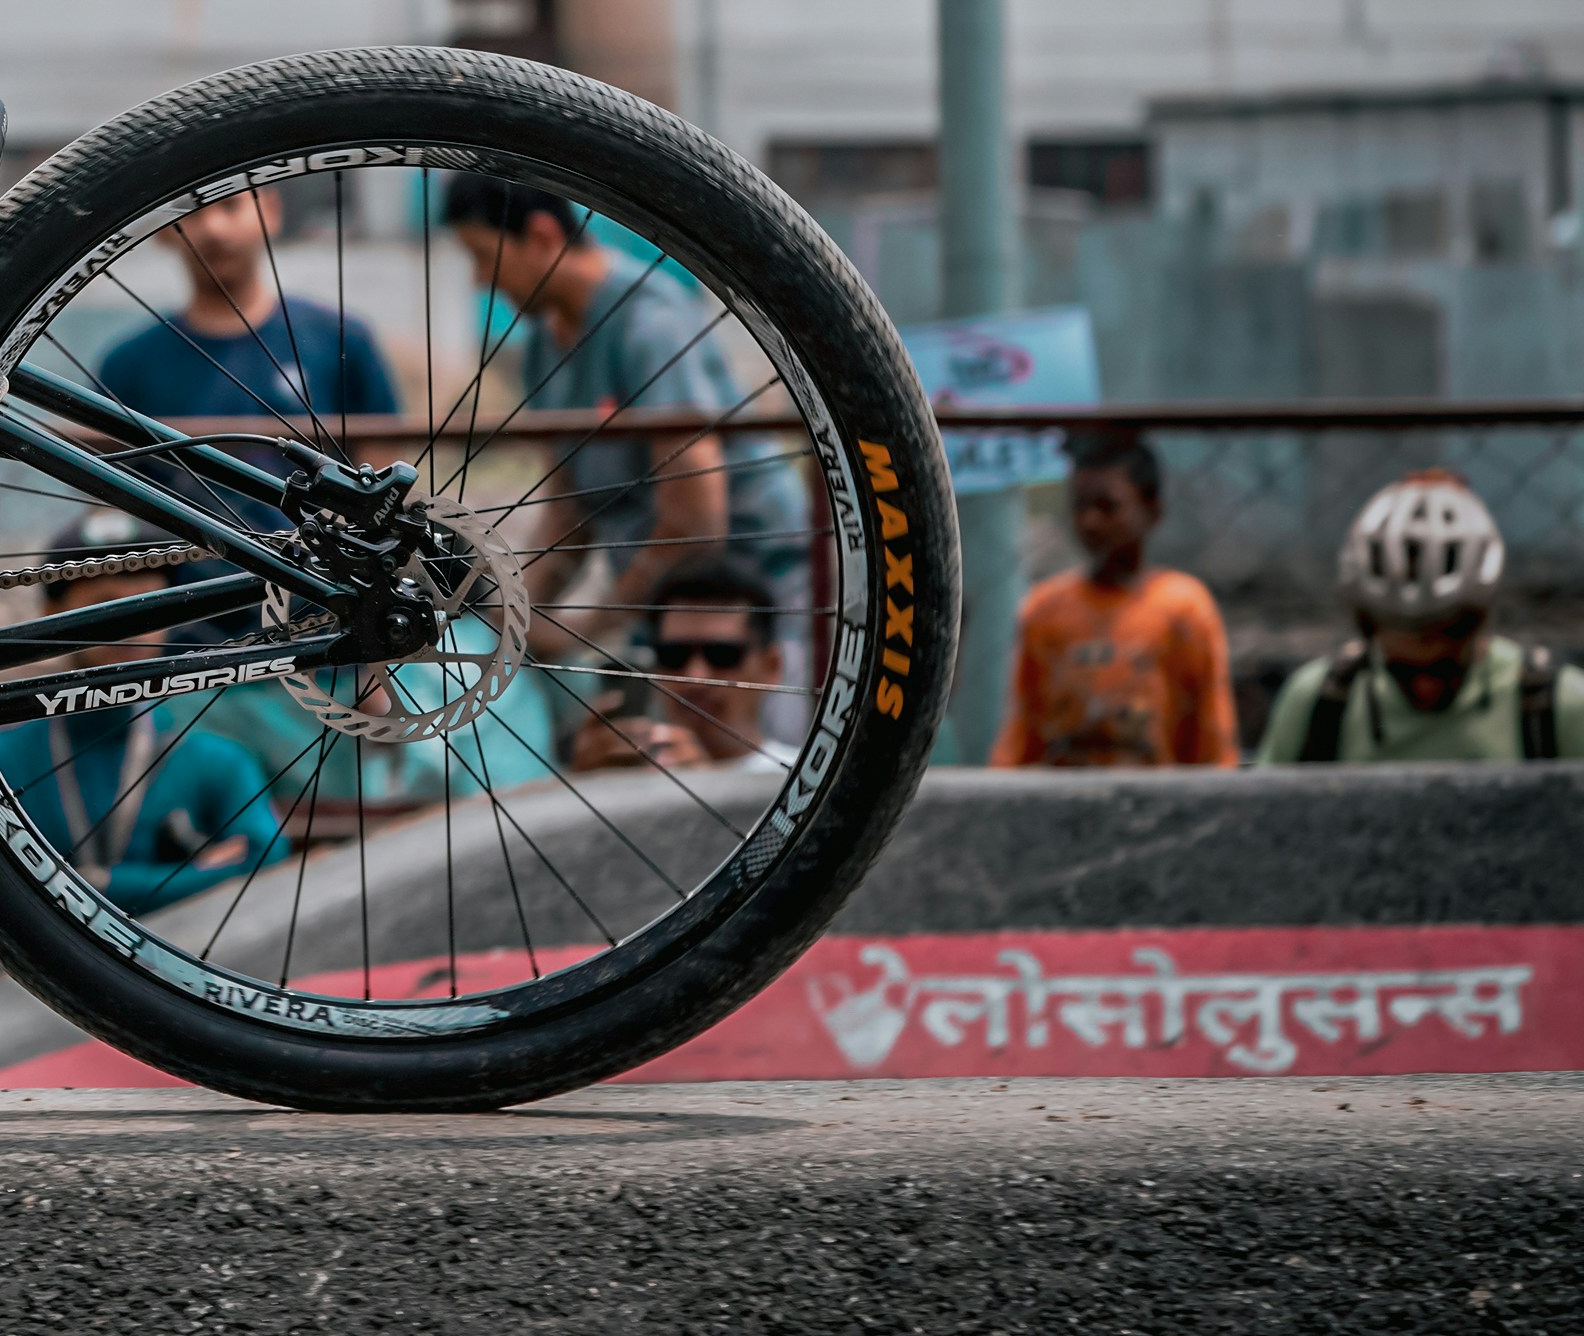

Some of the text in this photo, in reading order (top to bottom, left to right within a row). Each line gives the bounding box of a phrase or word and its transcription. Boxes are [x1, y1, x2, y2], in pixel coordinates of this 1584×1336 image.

[195, 145, 424, 205] KORE
[34, 230, 135, 323] RIVERA
[372, 487, 401, 527] Avid
[816, 427, 865, 553] RIVERA
[857, 438, 914, 721] MAXXIS
[769, 622, 867, 837] KORE
[202, 980, 335, 1027] RIVERA
